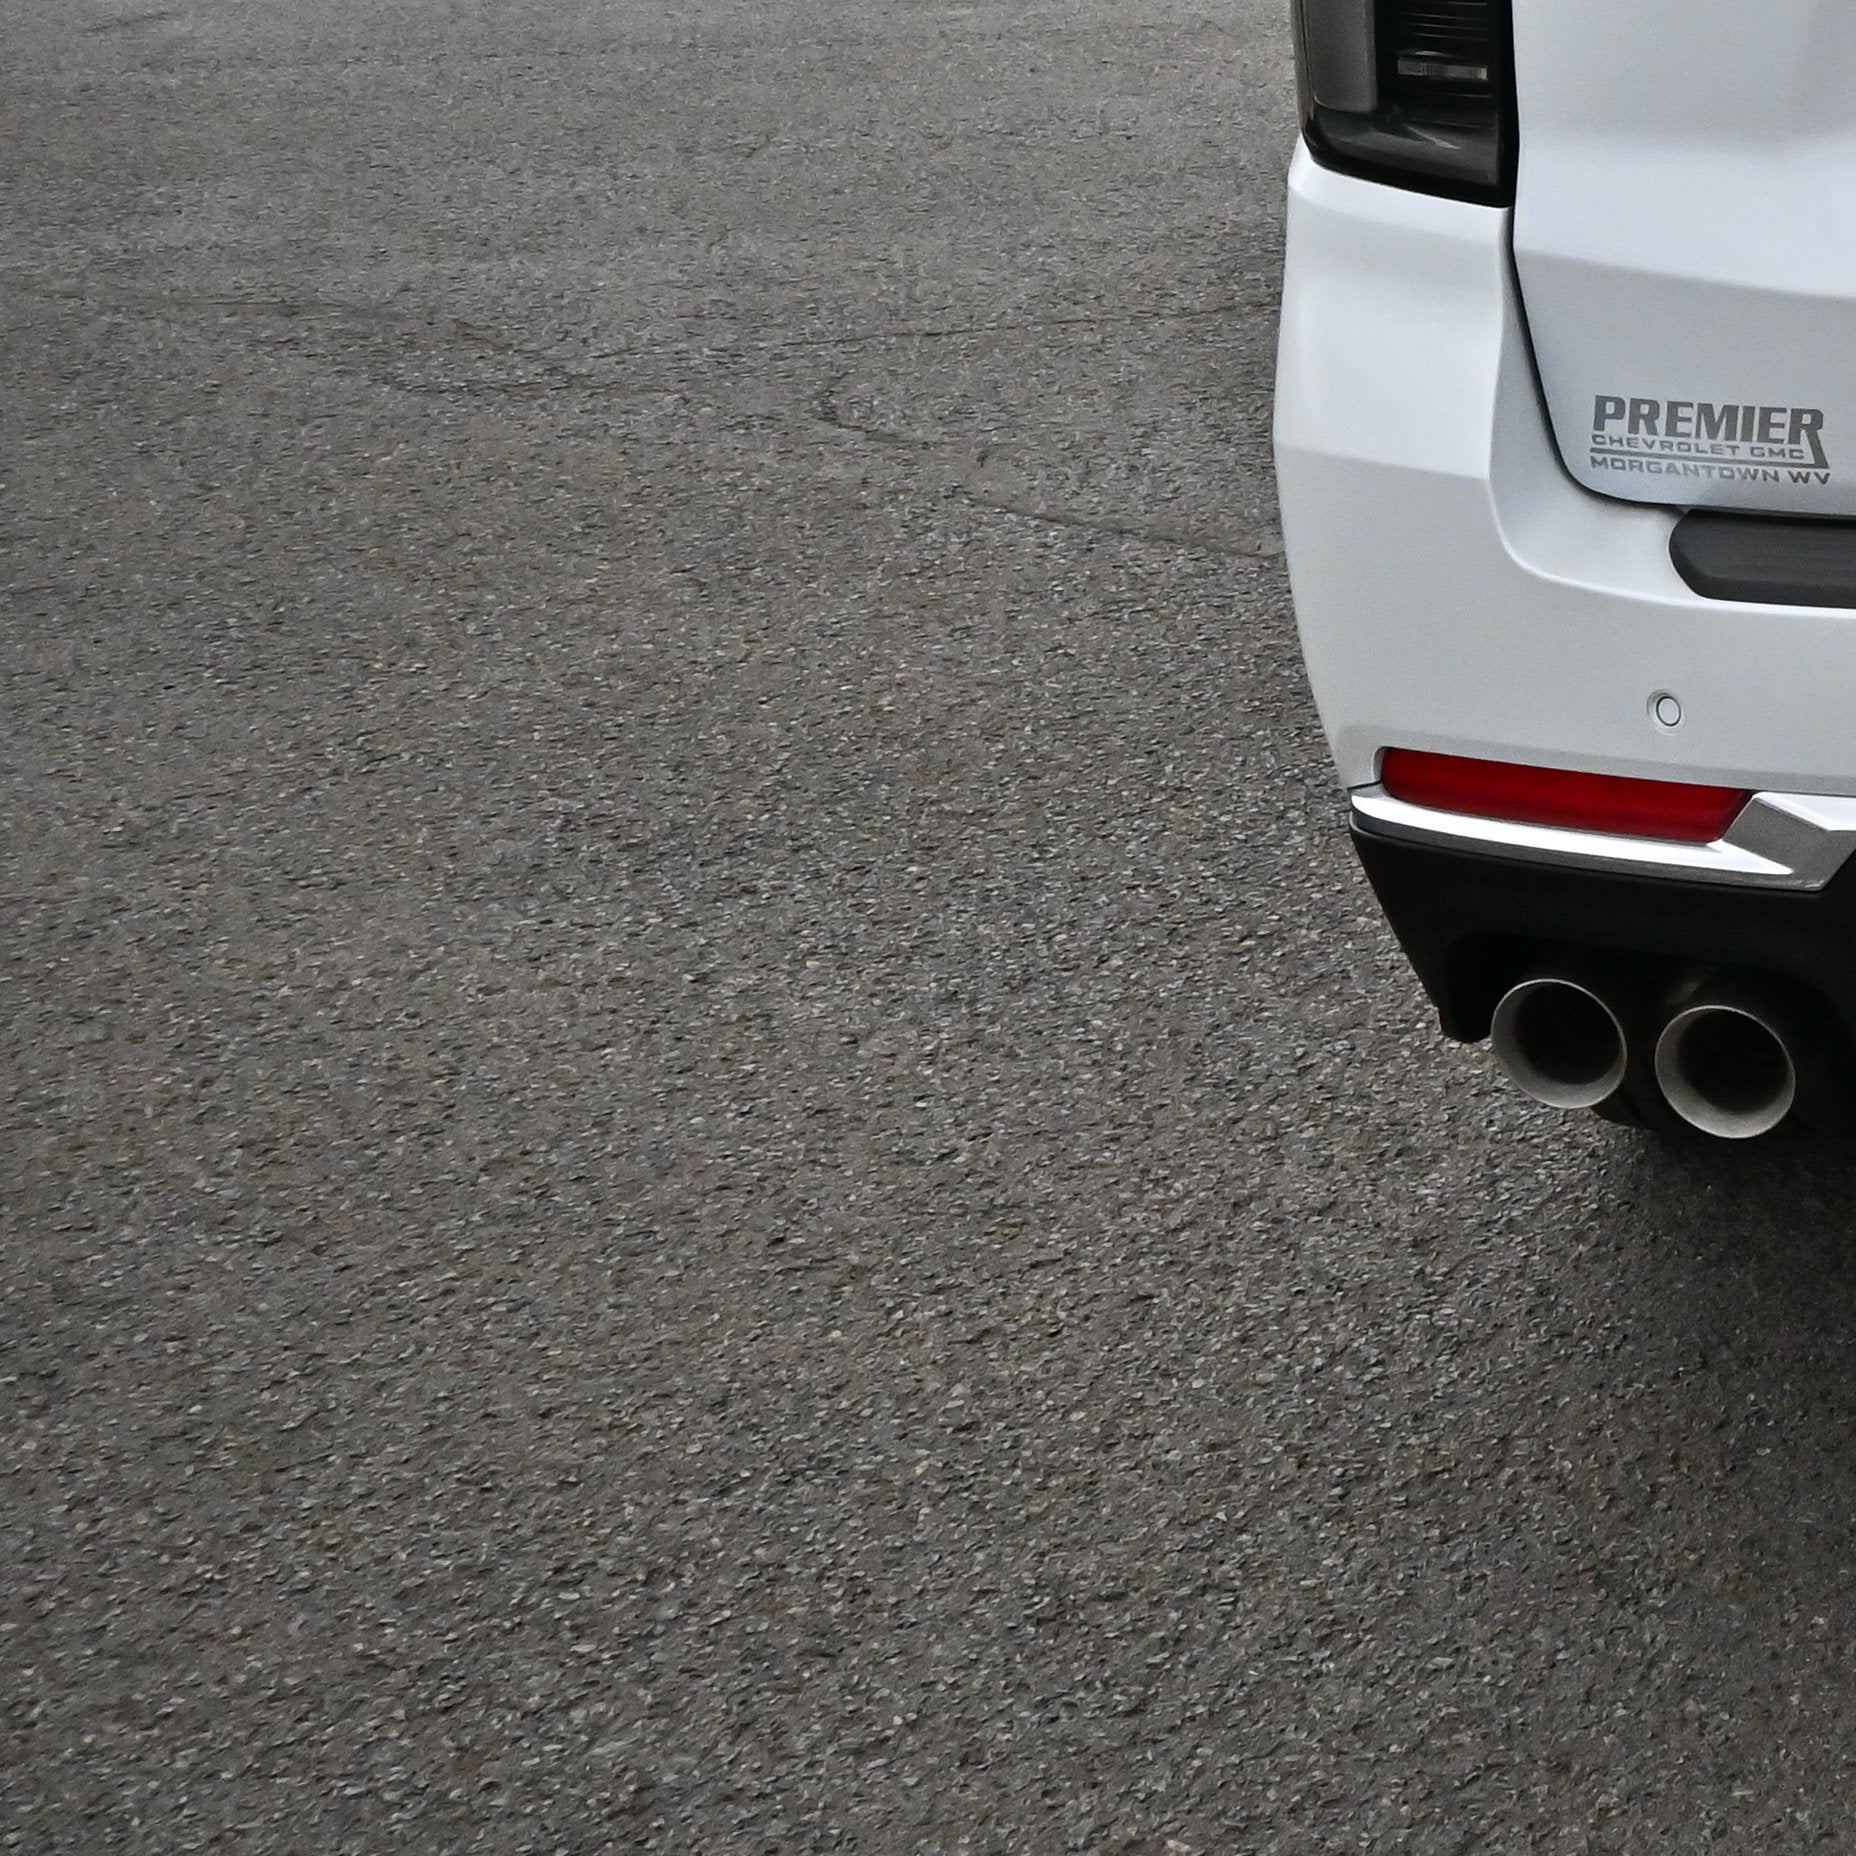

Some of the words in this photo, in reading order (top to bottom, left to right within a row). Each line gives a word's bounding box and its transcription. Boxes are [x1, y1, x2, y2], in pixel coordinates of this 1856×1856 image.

[1591, 433, 1741, 458] CHEVROLET
[1750, 445, 1806, 461] GMC
[1592, 394, 1830, 469] PREMIER
[1590, 455, 1780, 484] MORGANTOWN
[1787, 470, 1832, 486] WV
